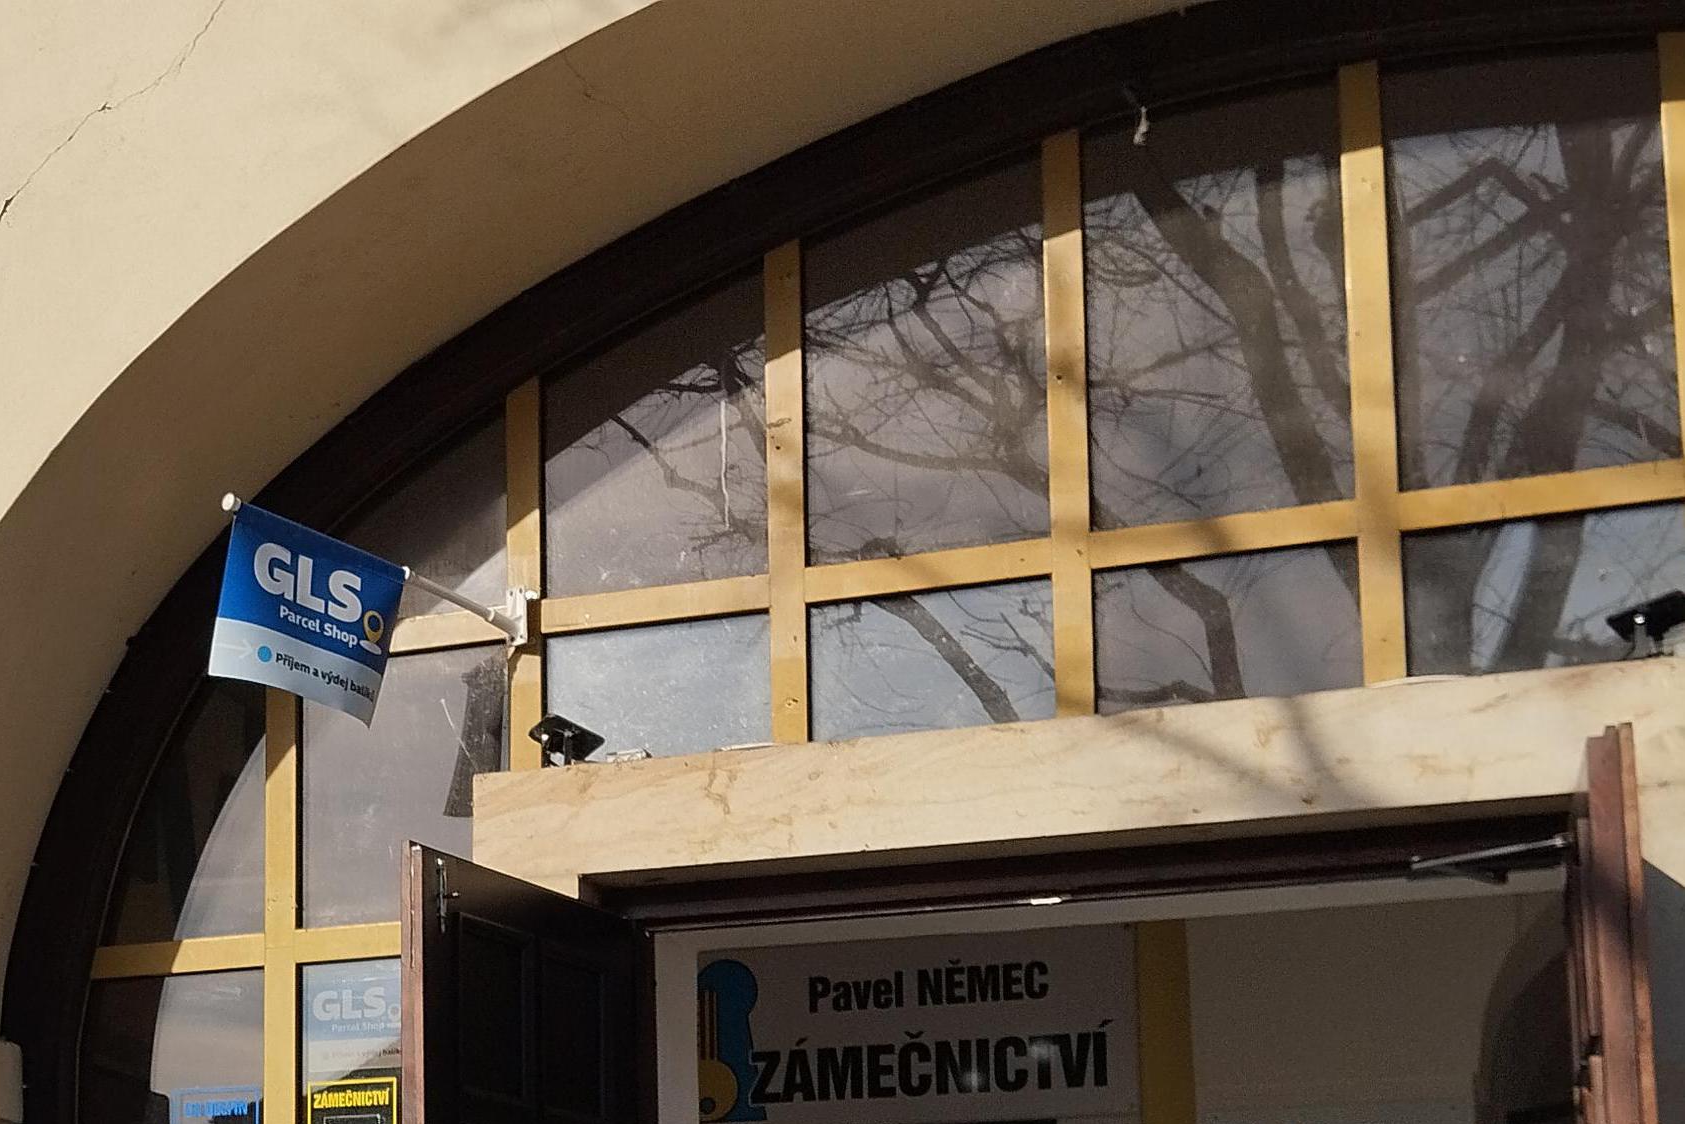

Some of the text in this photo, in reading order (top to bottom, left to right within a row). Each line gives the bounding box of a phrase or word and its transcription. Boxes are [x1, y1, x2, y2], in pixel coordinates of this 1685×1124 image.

[253, 542, 363, 624] GLS
[279, 605, 359, 650] Parcel Shop
[276, 652, 310, 675] Příjem
[312, 667, 319, 677] a
[320, 670, 349, 691] výdej
[313, 987, 386, 1021] GLS
[809, 958, 1049, 1014] Pavel NĚMEC
[751, 1018, 1113, 1105] ZÁMEČNICTVÍ
[313, 1087, 390, 1109] ZÁMEČNICTVÍ
